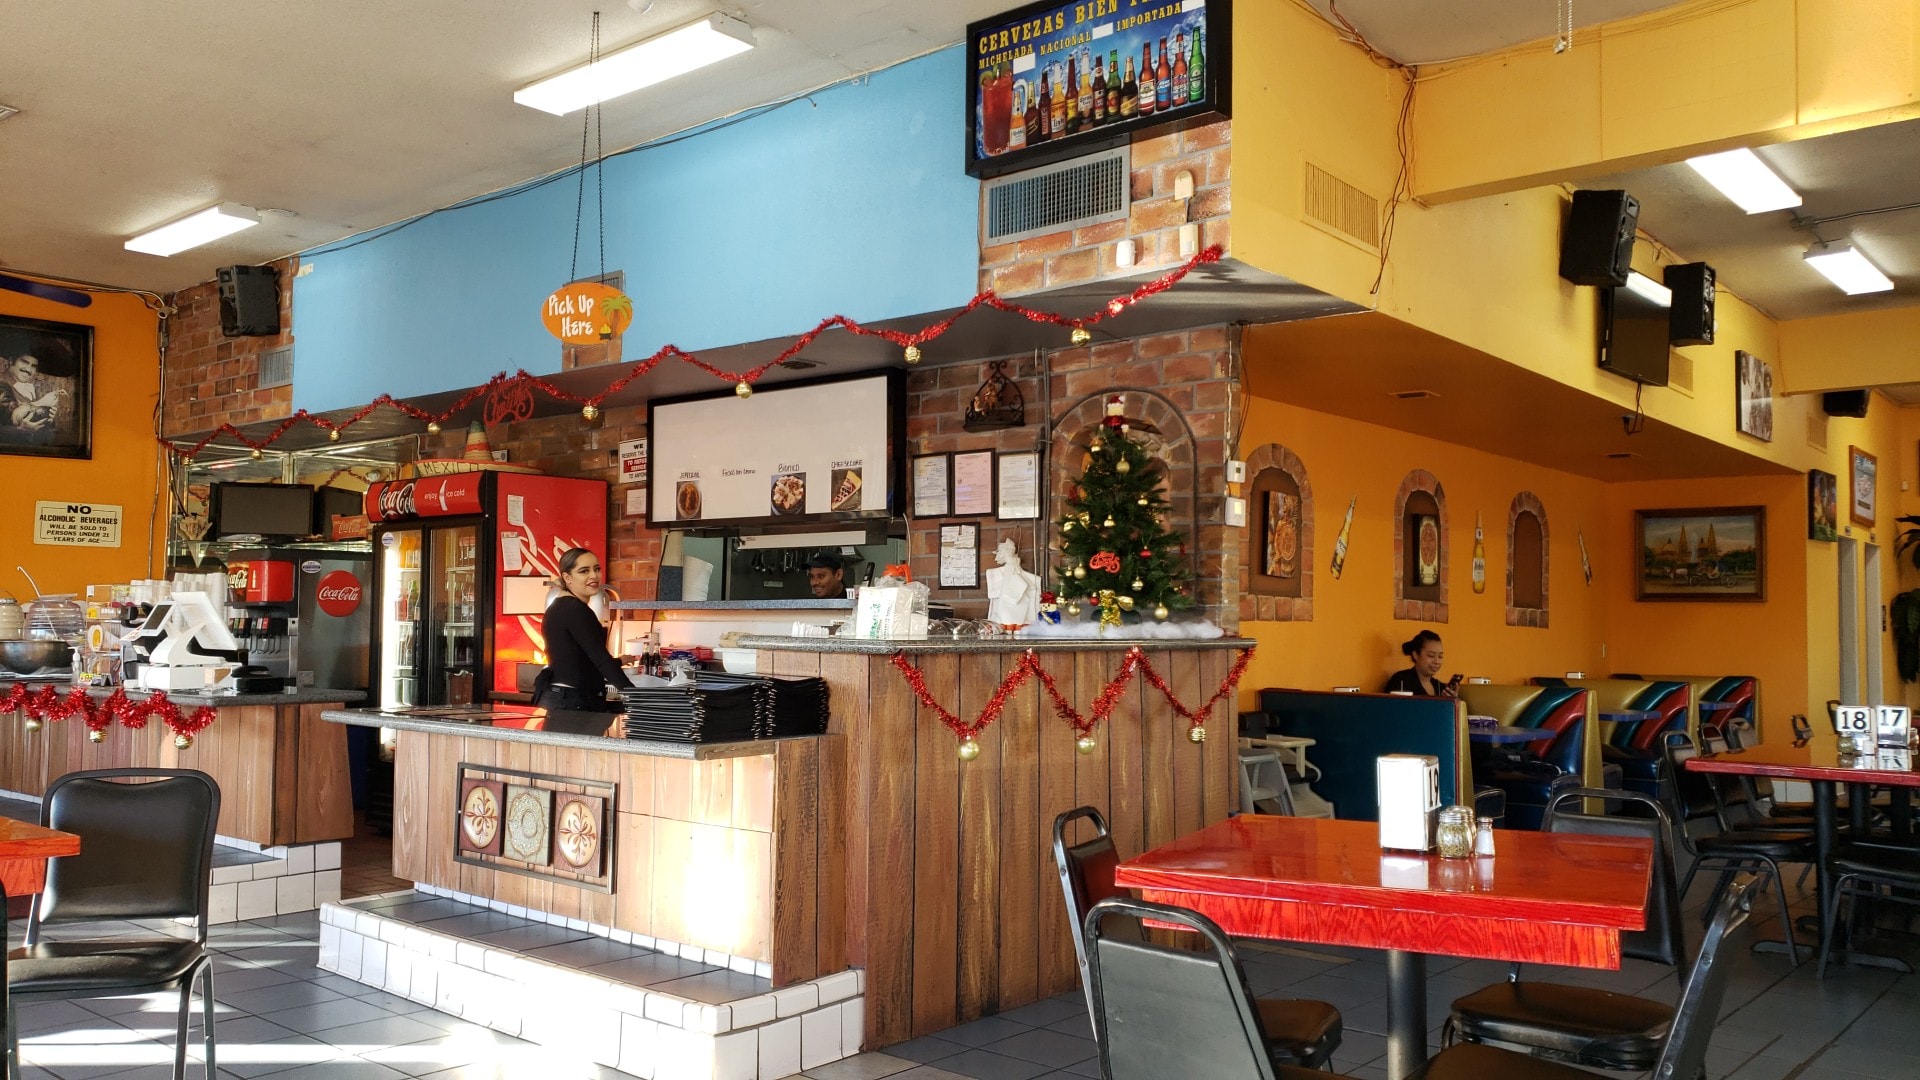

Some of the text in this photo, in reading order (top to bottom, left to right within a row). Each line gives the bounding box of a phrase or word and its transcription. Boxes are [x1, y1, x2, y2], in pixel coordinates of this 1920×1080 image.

[979, 0, 1117, 54] CERVEZAS BIEN
[979, 2, 1181, 69] MICHELADA NACIONAL IMPORTADA
[548, 294, 594, 317] Pick Up
[561, 315, 593, 337] Here
[424, 492, 437, 501] enjoy
[454, 488, 465, 497] cold
[40, 514, 118, 525] ALCOHOLIC BEVERAGES
[67, 505, 92, 515] NO
[319, 586, 360, 601] Coca-Cola
[1841, 711, 1867, 730] 18
[1880, 709, 1904, 727] 17
[1429, 768, 1438, 807] 19
